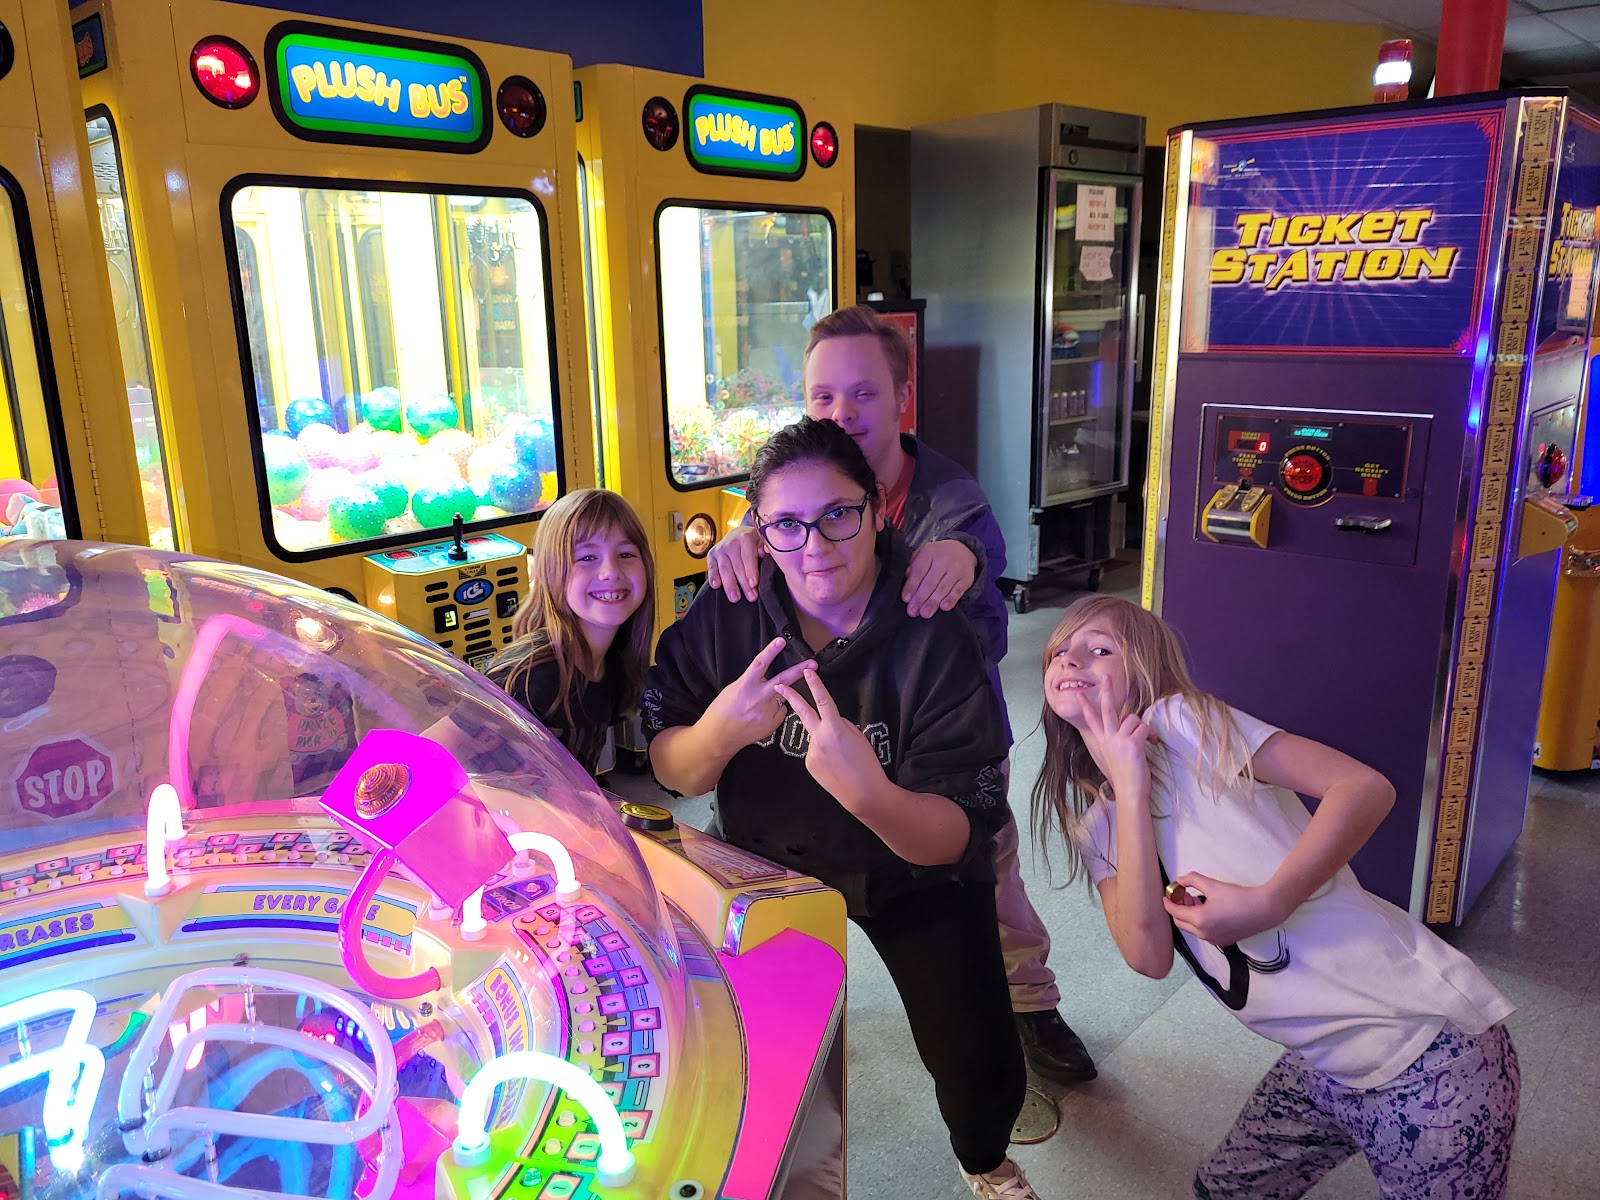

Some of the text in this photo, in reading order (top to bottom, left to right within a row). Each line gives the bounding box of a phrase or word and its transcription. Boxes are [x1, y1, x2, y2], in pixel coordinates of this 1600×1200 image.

[291, 61, 401, 112] PLUSH
[408, 79, 468, 118] BUS
[695, 113, 794, 155] PLUSH BUS
[1526, 171, 1535, 197] TICKET
[1235, 210, 1434, 248] TICKET
[1519, 226, 1528, 253] TICKET
[1208, 248, 1459, 290] STATION
[1513, 280, 1521, 304] TICKET
[1500, 383, 1508, 408] TICKET
[1259, 442, 1267, 451] 0
[1492, 434, 1501, 457] TICKET
[1480, 532, 1488, 554] TICKET
[462, 582, 484, 600] ICE
[1474, 580, 1482, 602] TICKET
[1468, 626, 1476, 648] TICKET
[1462, 672, 1470, 693] TICKET
[298, 714, 337, 732] PRIZE
[1457, 717, 1465, 738] TICKET
[1451, 762, 1459, 782] TICKET
[24, 760, 106, 808] STOP
[1440, 847, 1448, 867] TICKET
[253, 894, 380, 921] EVERY GE
[1435, 889, 1443, 909] TICKET
[489, 973, 521, 1031] BONUS
